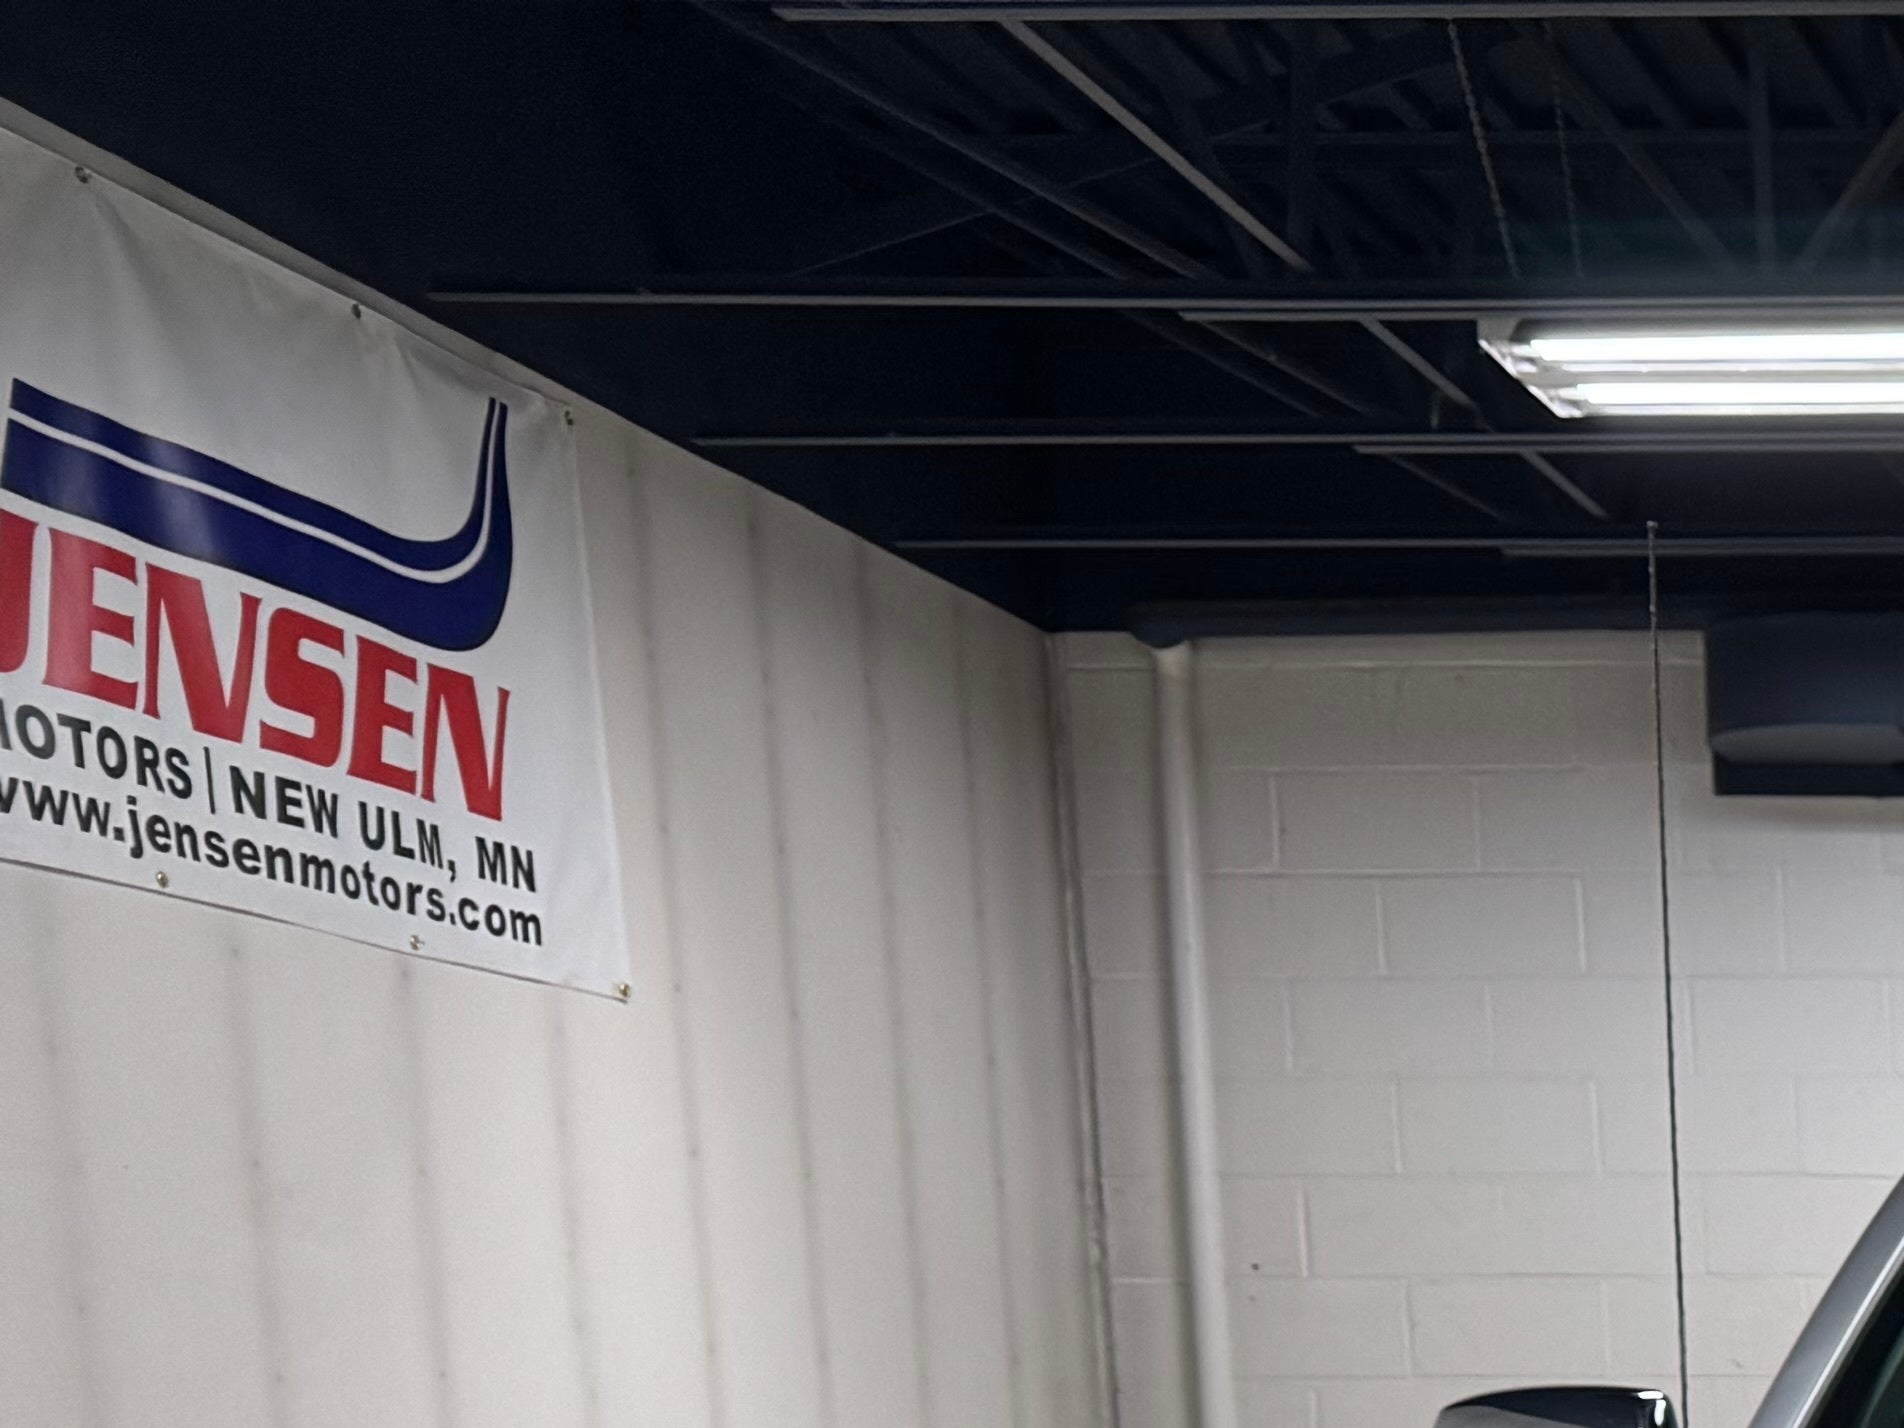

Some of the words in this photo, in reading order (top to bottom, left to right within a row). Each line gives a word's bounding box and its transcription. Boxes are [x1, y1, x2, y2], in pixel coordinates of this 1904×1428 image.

[0, 697, 193, 800] OTORS
[229, 764, 339, 839] NEW
[358, 800, 456, 882] ULM,
[475, 836, 537, 893] MN
